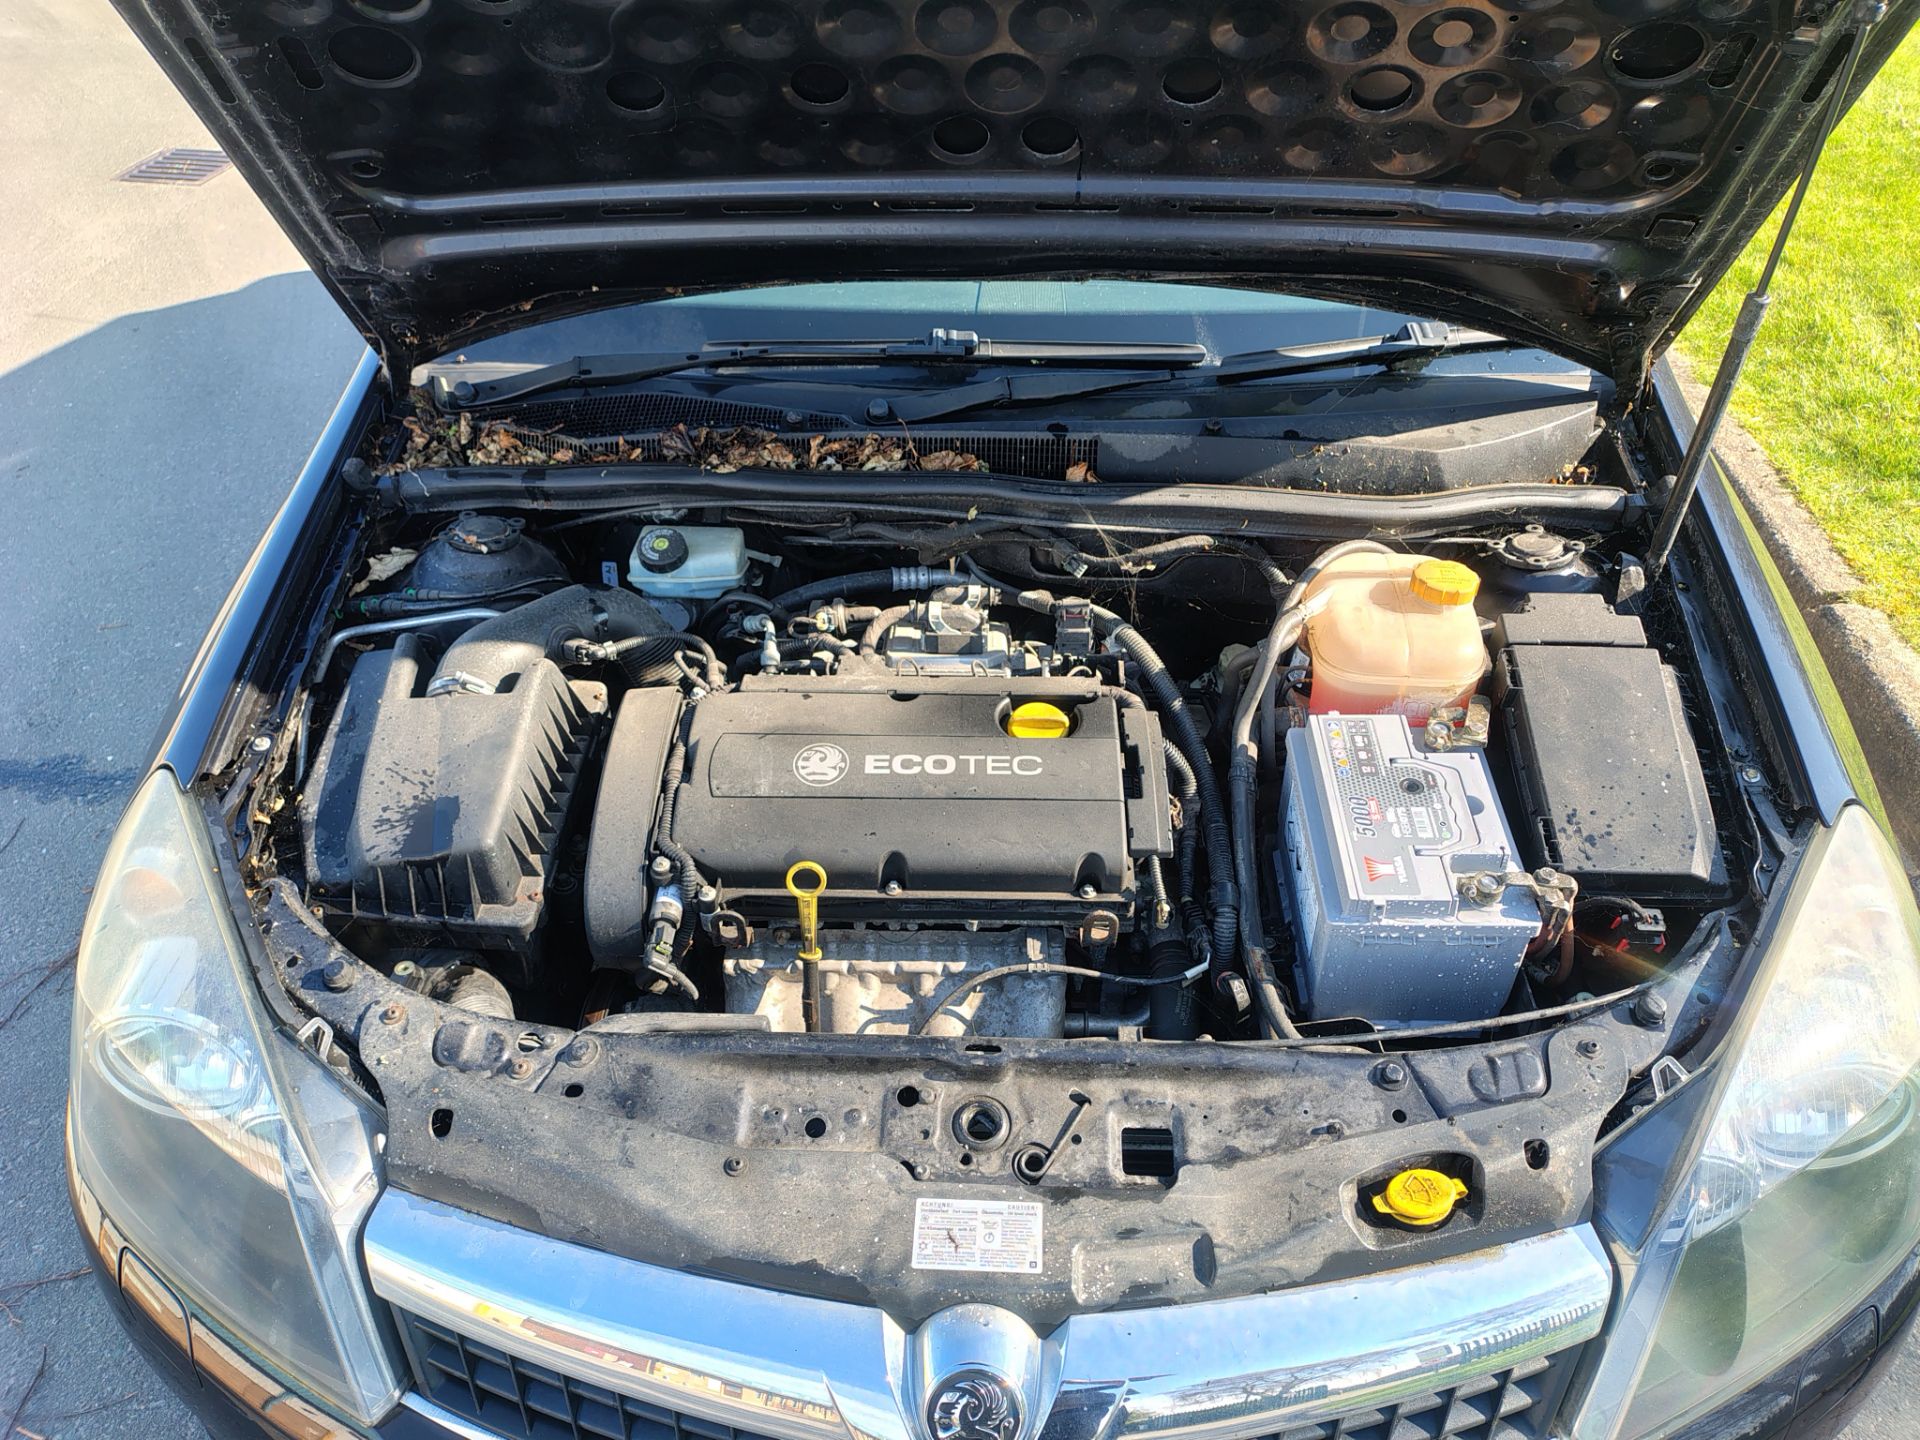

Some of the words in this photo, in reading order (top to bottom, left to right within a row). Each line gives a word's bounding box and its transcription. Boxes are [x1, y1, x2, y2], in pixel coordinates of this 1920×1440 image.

[864, 753, 1044, 776] ECOTEC
[1349, 796, 1377, 838] 5000
[1393, 855, 1409, 884] YUASA
